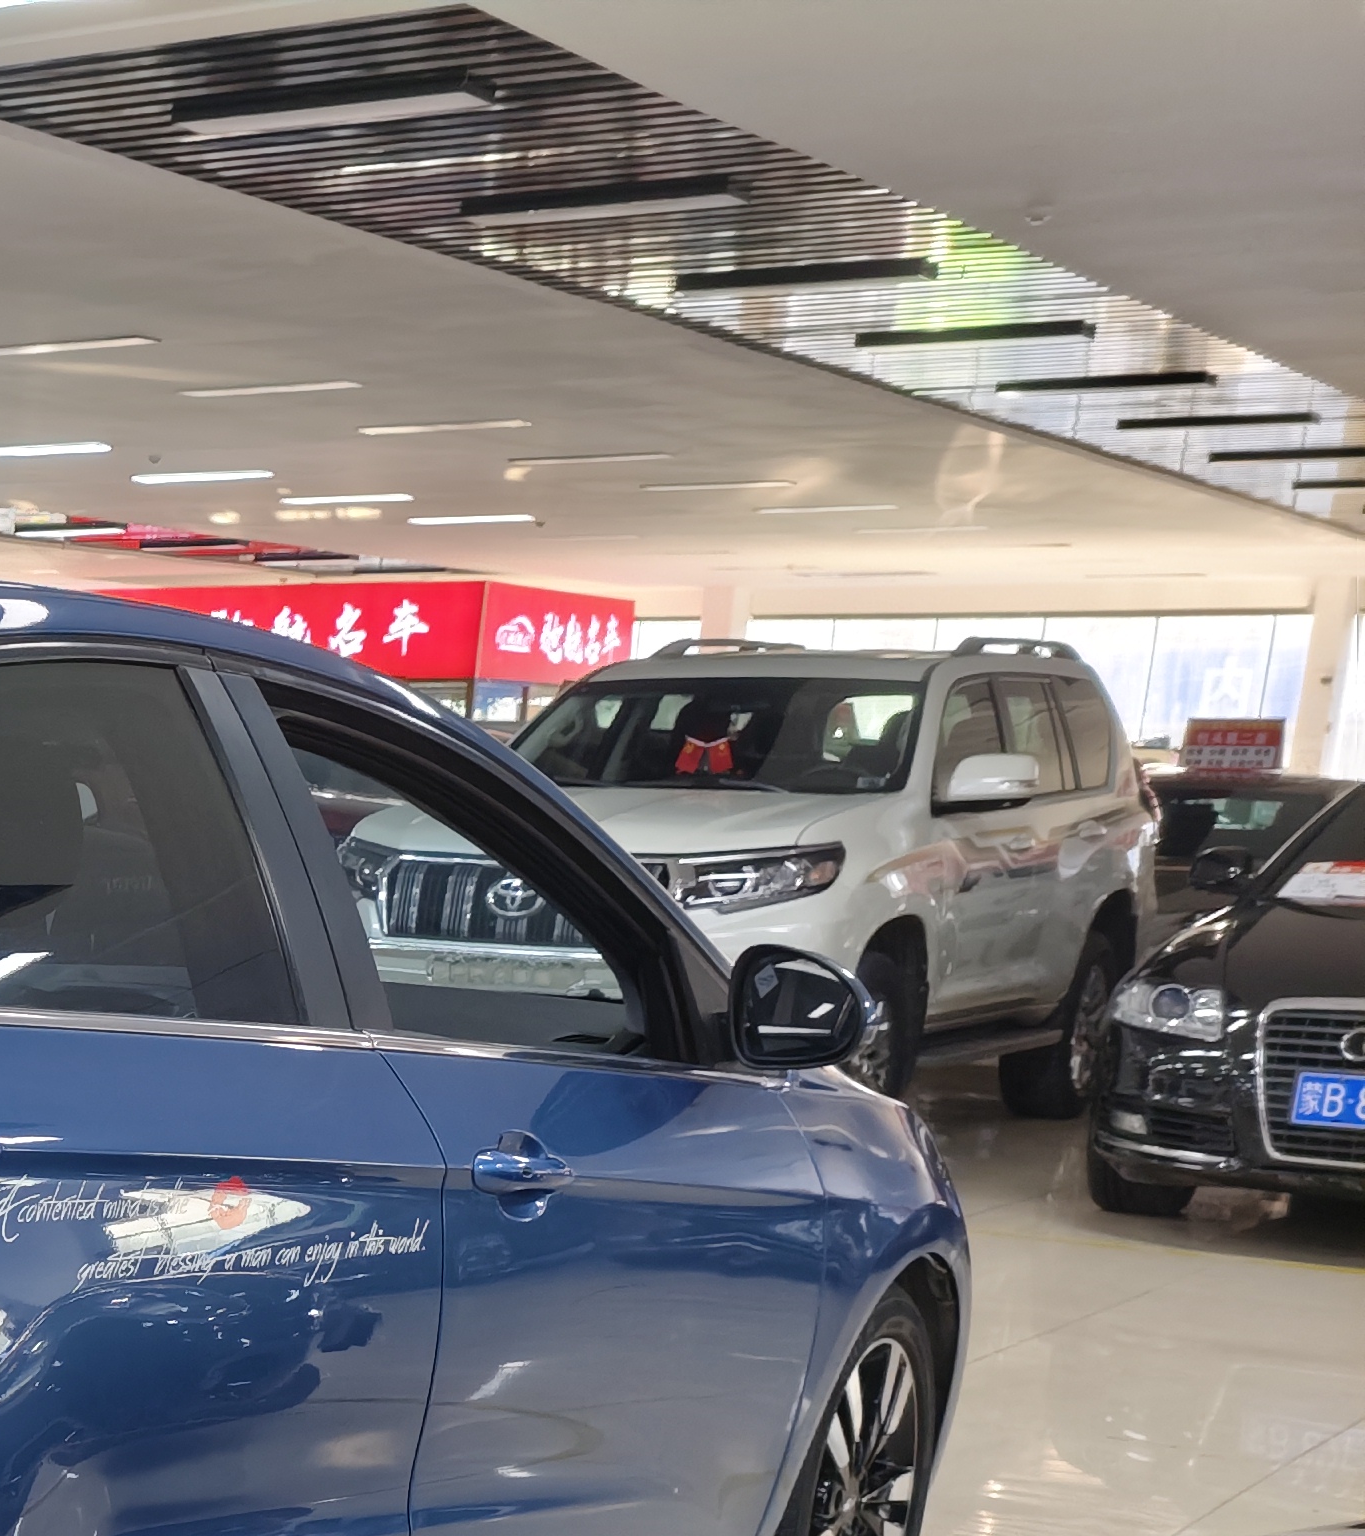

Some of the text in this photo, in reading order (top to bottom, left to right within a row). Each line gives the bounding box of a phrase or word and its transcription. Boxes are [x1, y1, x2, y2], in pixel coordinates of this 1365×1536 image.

[18, 1178, 106, 1223] contented
[240, 1245, 272, 1269] man
[275, 1245, 302, 1268] can
[303, 1235, 344, 1288] enjoy
[359, 1219, 391, 1258] this
